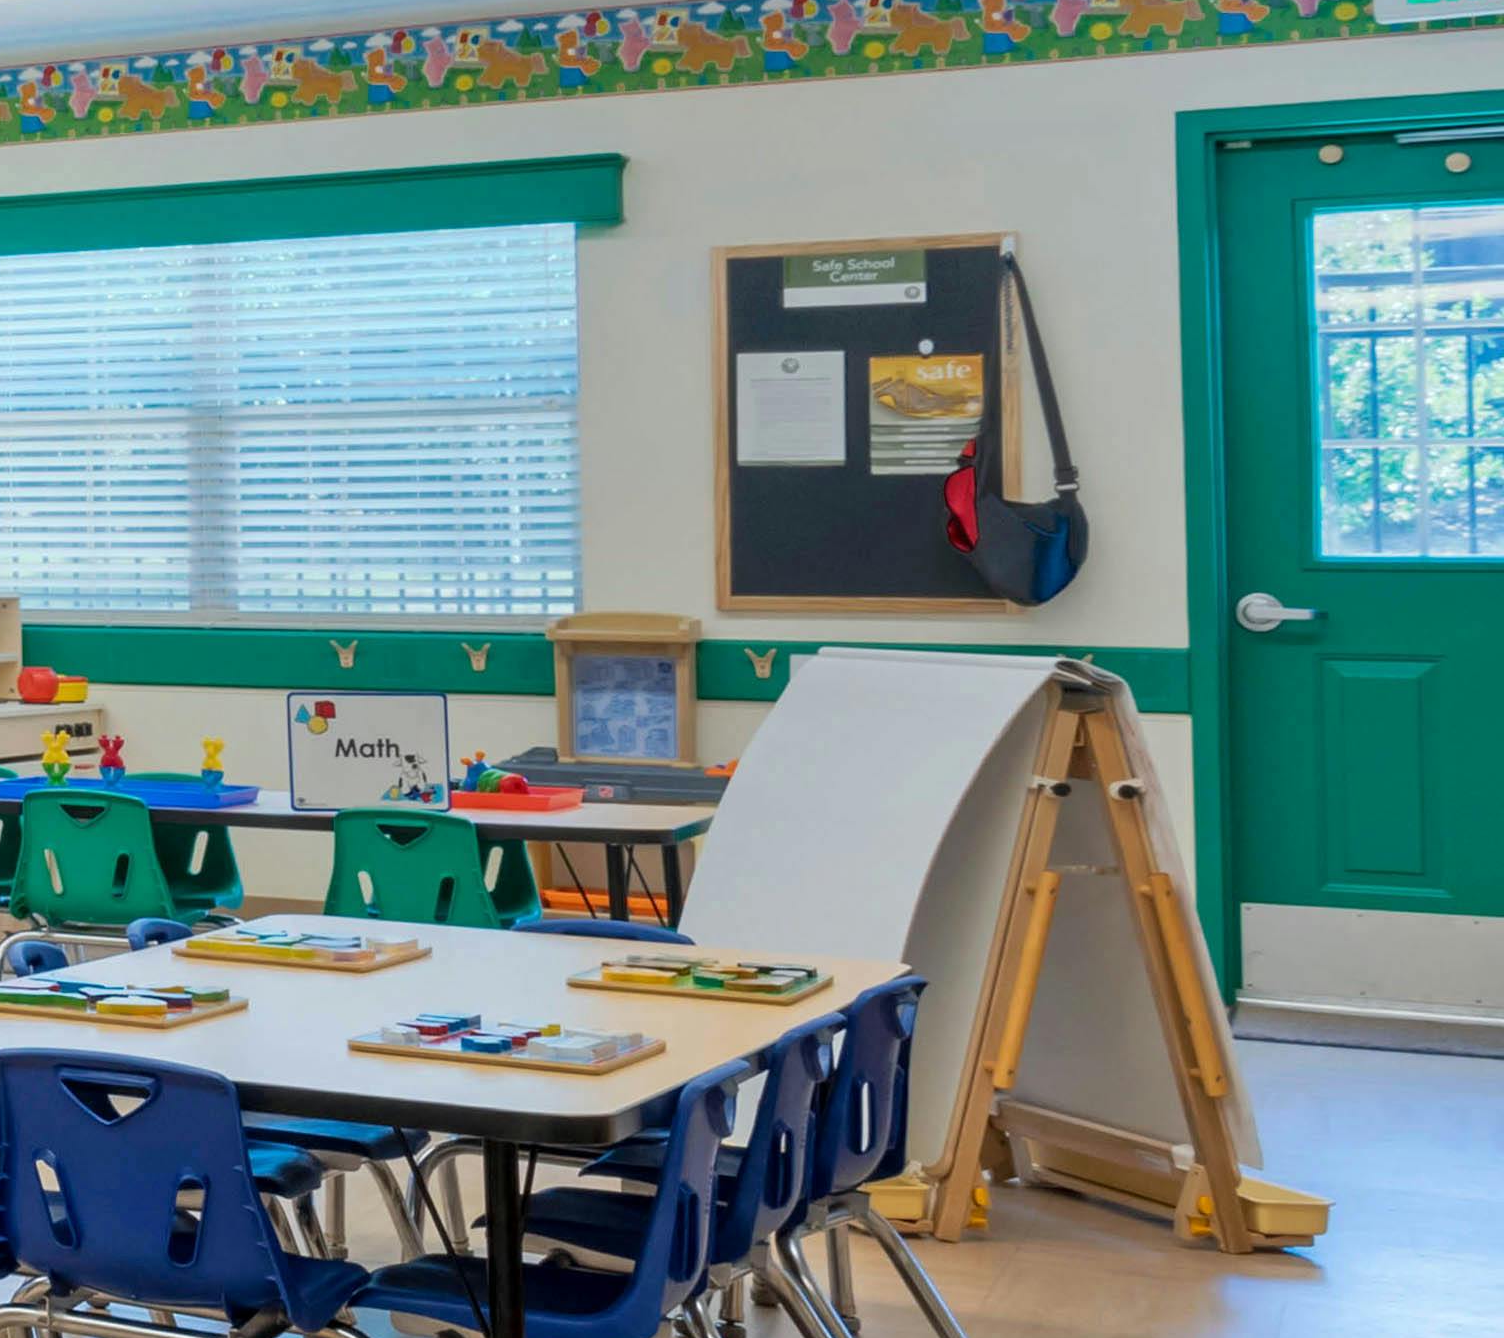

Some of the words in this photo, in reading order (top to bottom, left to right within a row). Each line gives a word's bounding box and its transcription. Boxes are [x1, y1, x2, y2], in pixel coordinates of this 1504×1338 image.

[813, 259, 843, 272] Safe
[848, 256, 895, 270] School
[830, 270, 879, 283] Center
[916, 361, 973, 380] safe
[335, 738, 400, 758] Math
